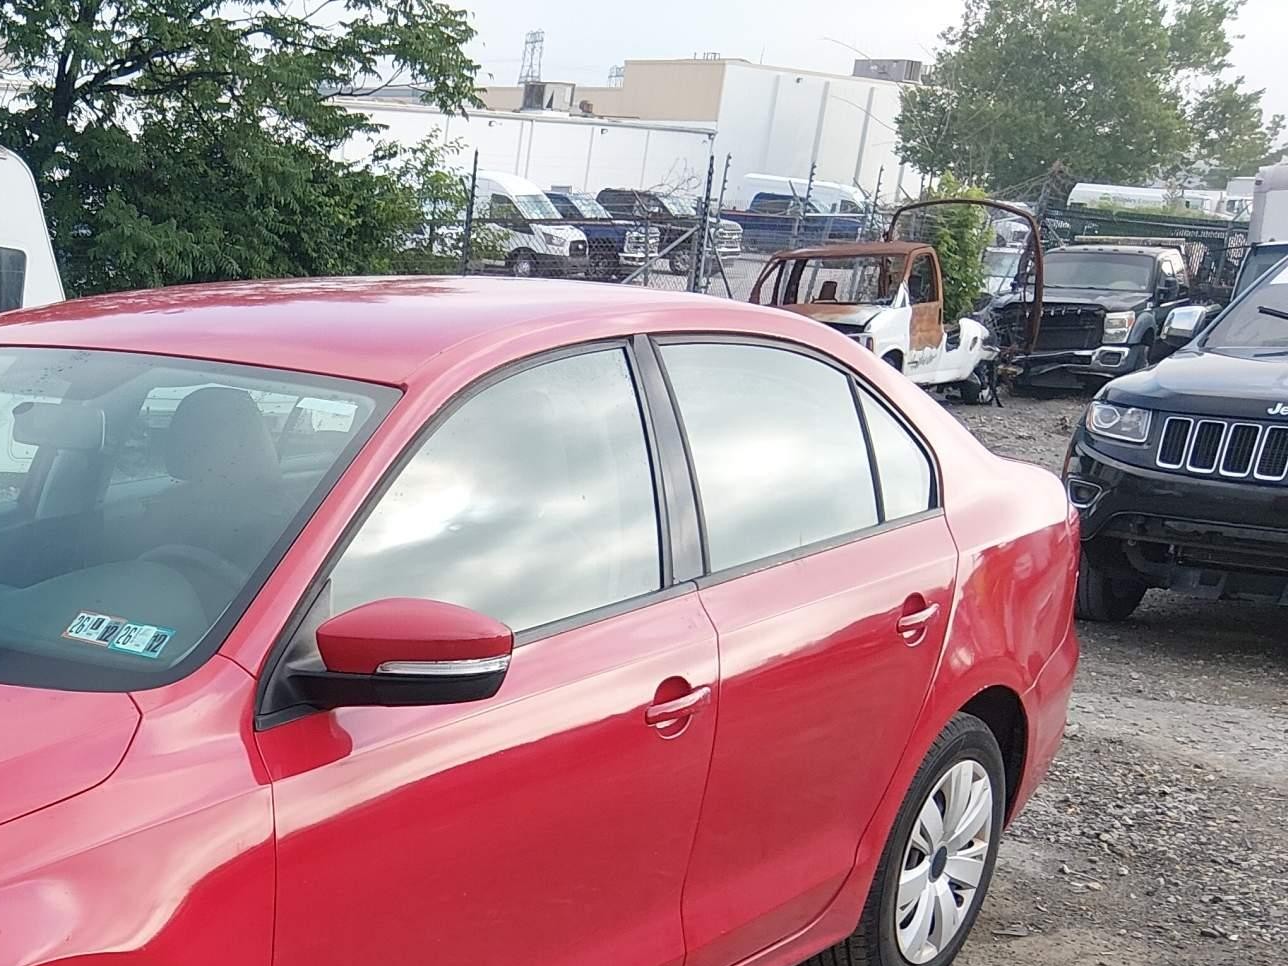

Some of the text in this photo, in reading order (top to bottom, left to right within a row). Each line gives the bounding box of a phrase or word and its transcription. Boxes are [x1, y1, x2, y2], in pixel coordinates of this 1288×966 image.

[68, 615, 91, 635] 26
[98, 624, 119, 643] 12
[115, 625, 168, 653] 26 12
